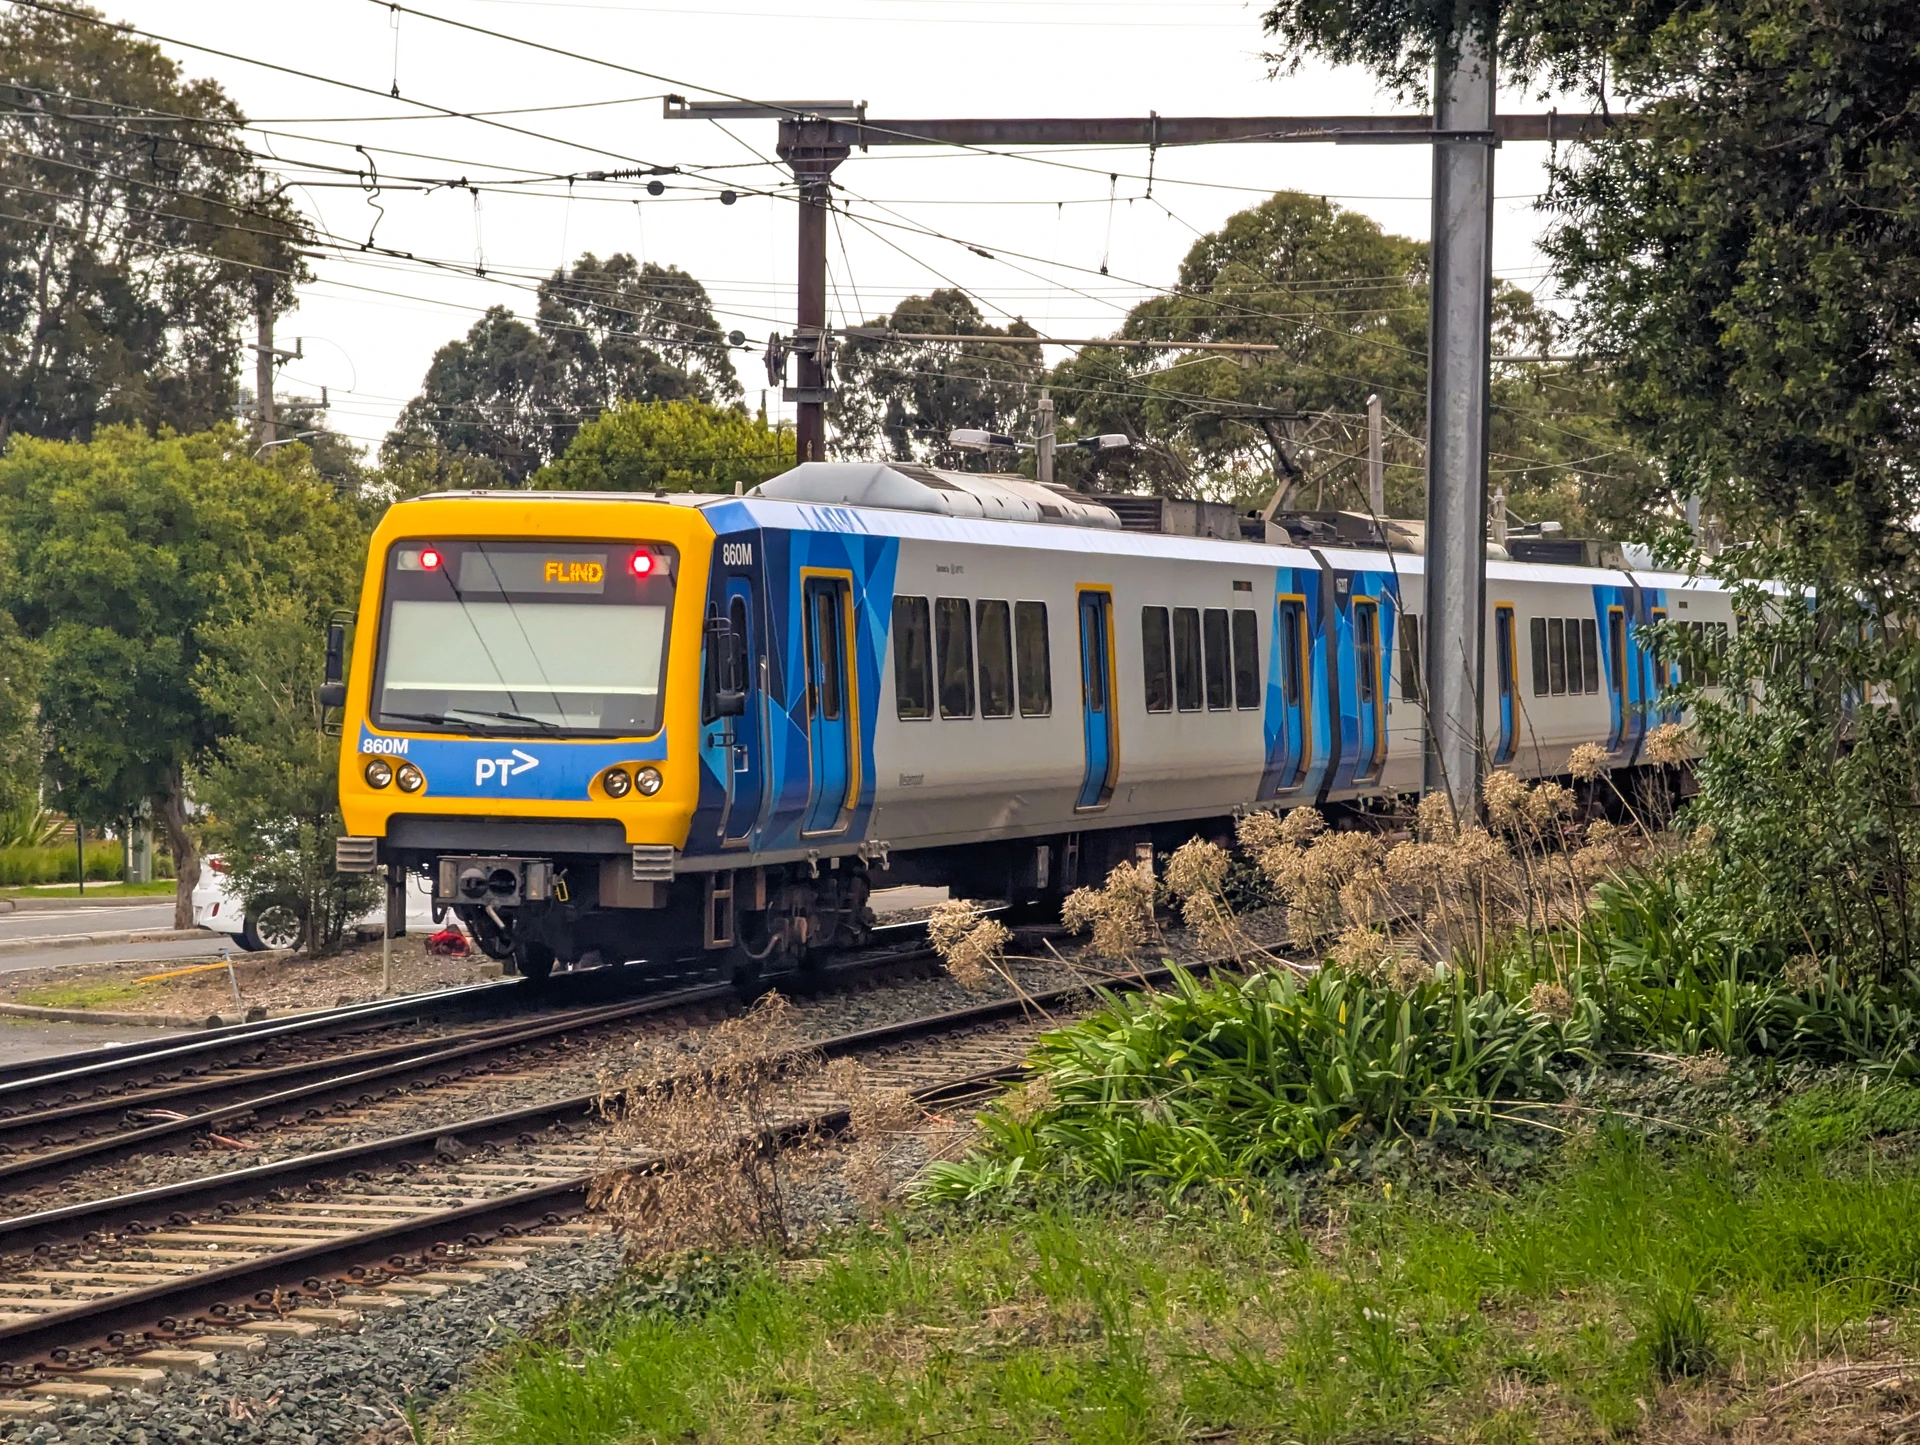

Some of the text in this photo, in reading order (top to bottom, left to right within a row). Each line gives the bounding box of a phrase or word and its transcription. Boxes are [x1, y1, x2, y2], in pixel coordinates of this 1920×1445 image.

[723, 543, 752, 566] 860M
[545, 561, 604, 583] FLIND
[363, 738, 409, 754] 860M
